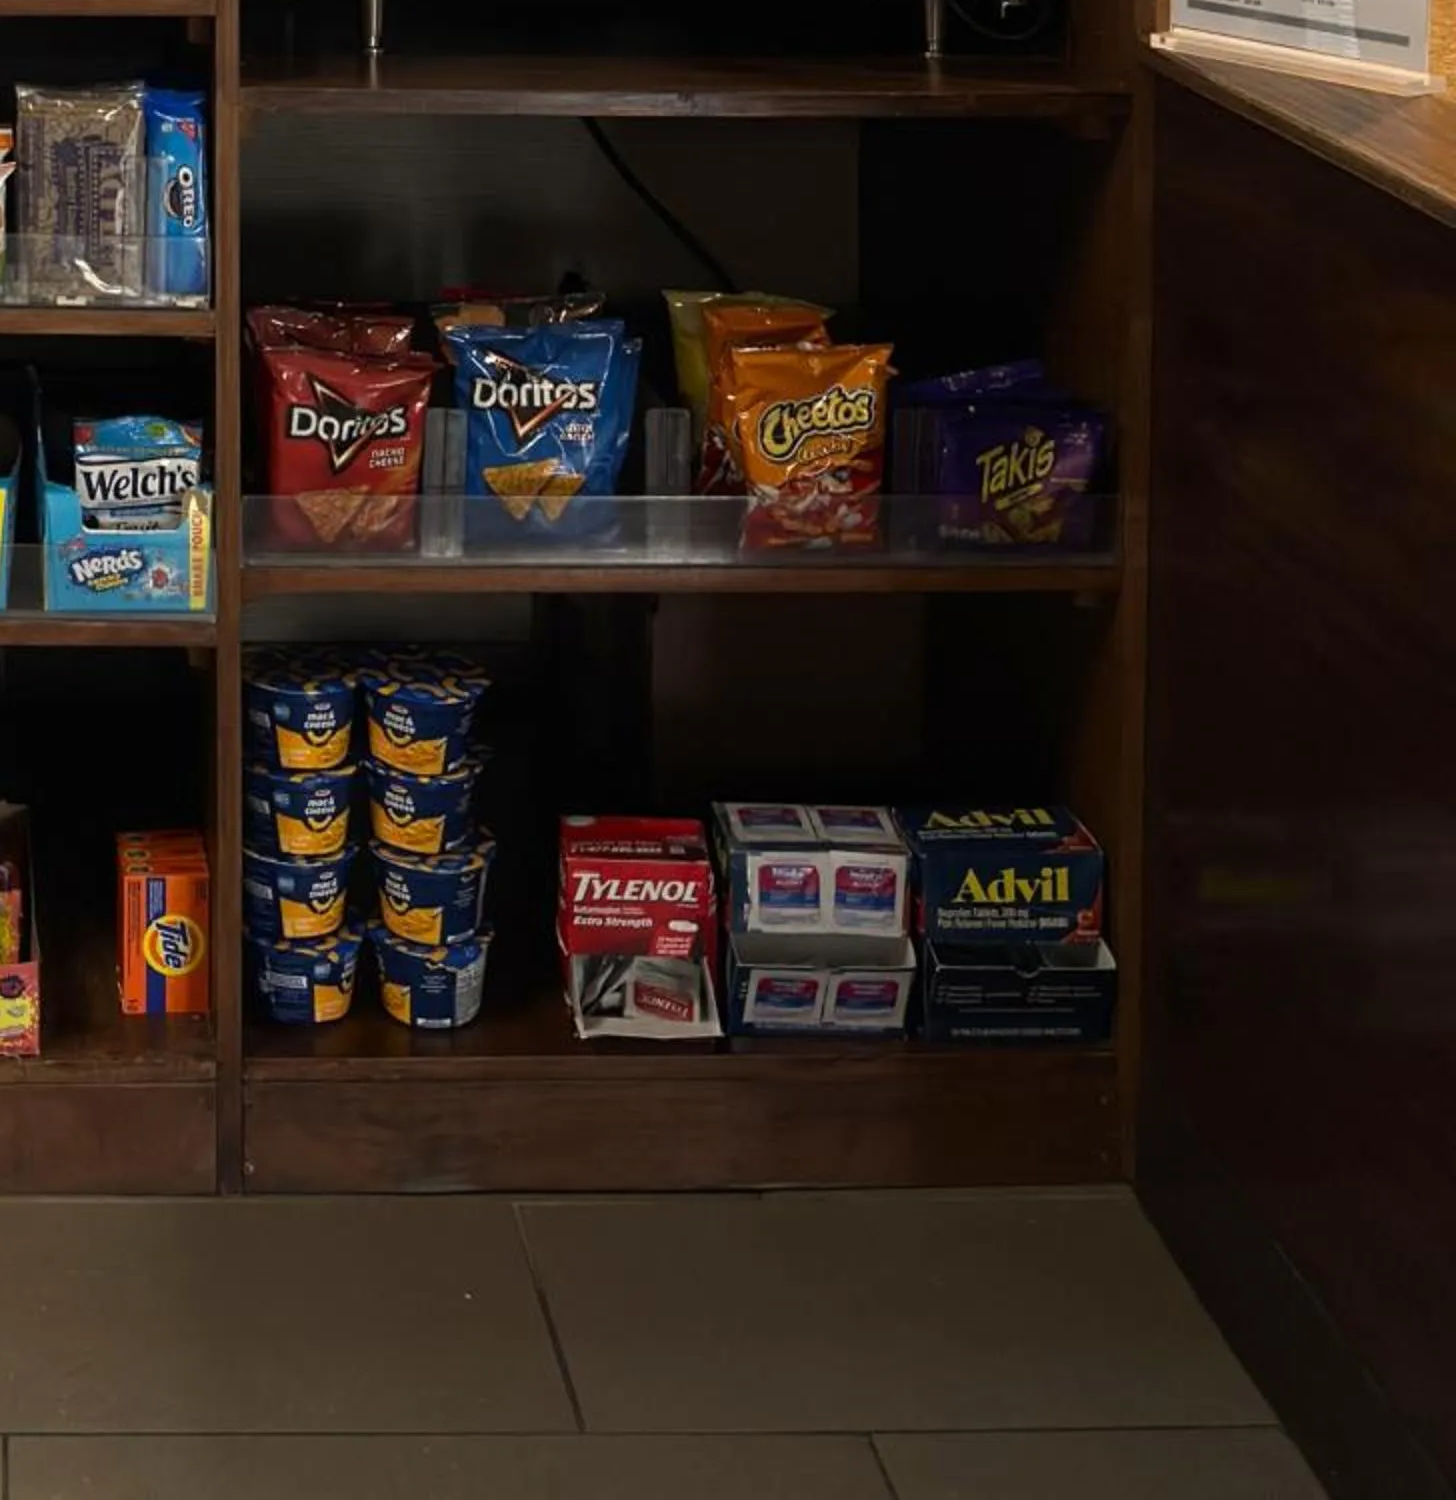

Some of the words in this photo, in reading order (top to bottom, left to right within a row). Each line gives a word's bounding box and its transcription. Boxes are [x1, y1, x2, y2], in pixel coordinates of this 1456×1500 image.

[177, 165, 195, 228] OREO
[473, 378, 597, 411] Doritos
[290, 406, 408, 442] Doritos
[761, 388, 873, 456] Cheetos
[81, 466, 196, 501] Welch's
[976, 437, 1056, 503] Takis
[923, 807, 1056, 828] Advil
[572, 871, 700, 903] TYLENOL
[952, 866, 1070, 903] Advil
[573, 916, 604, 927] Extra
[605, 916, 653, 929] Strength
[155, 921, 190, 970] Tide
